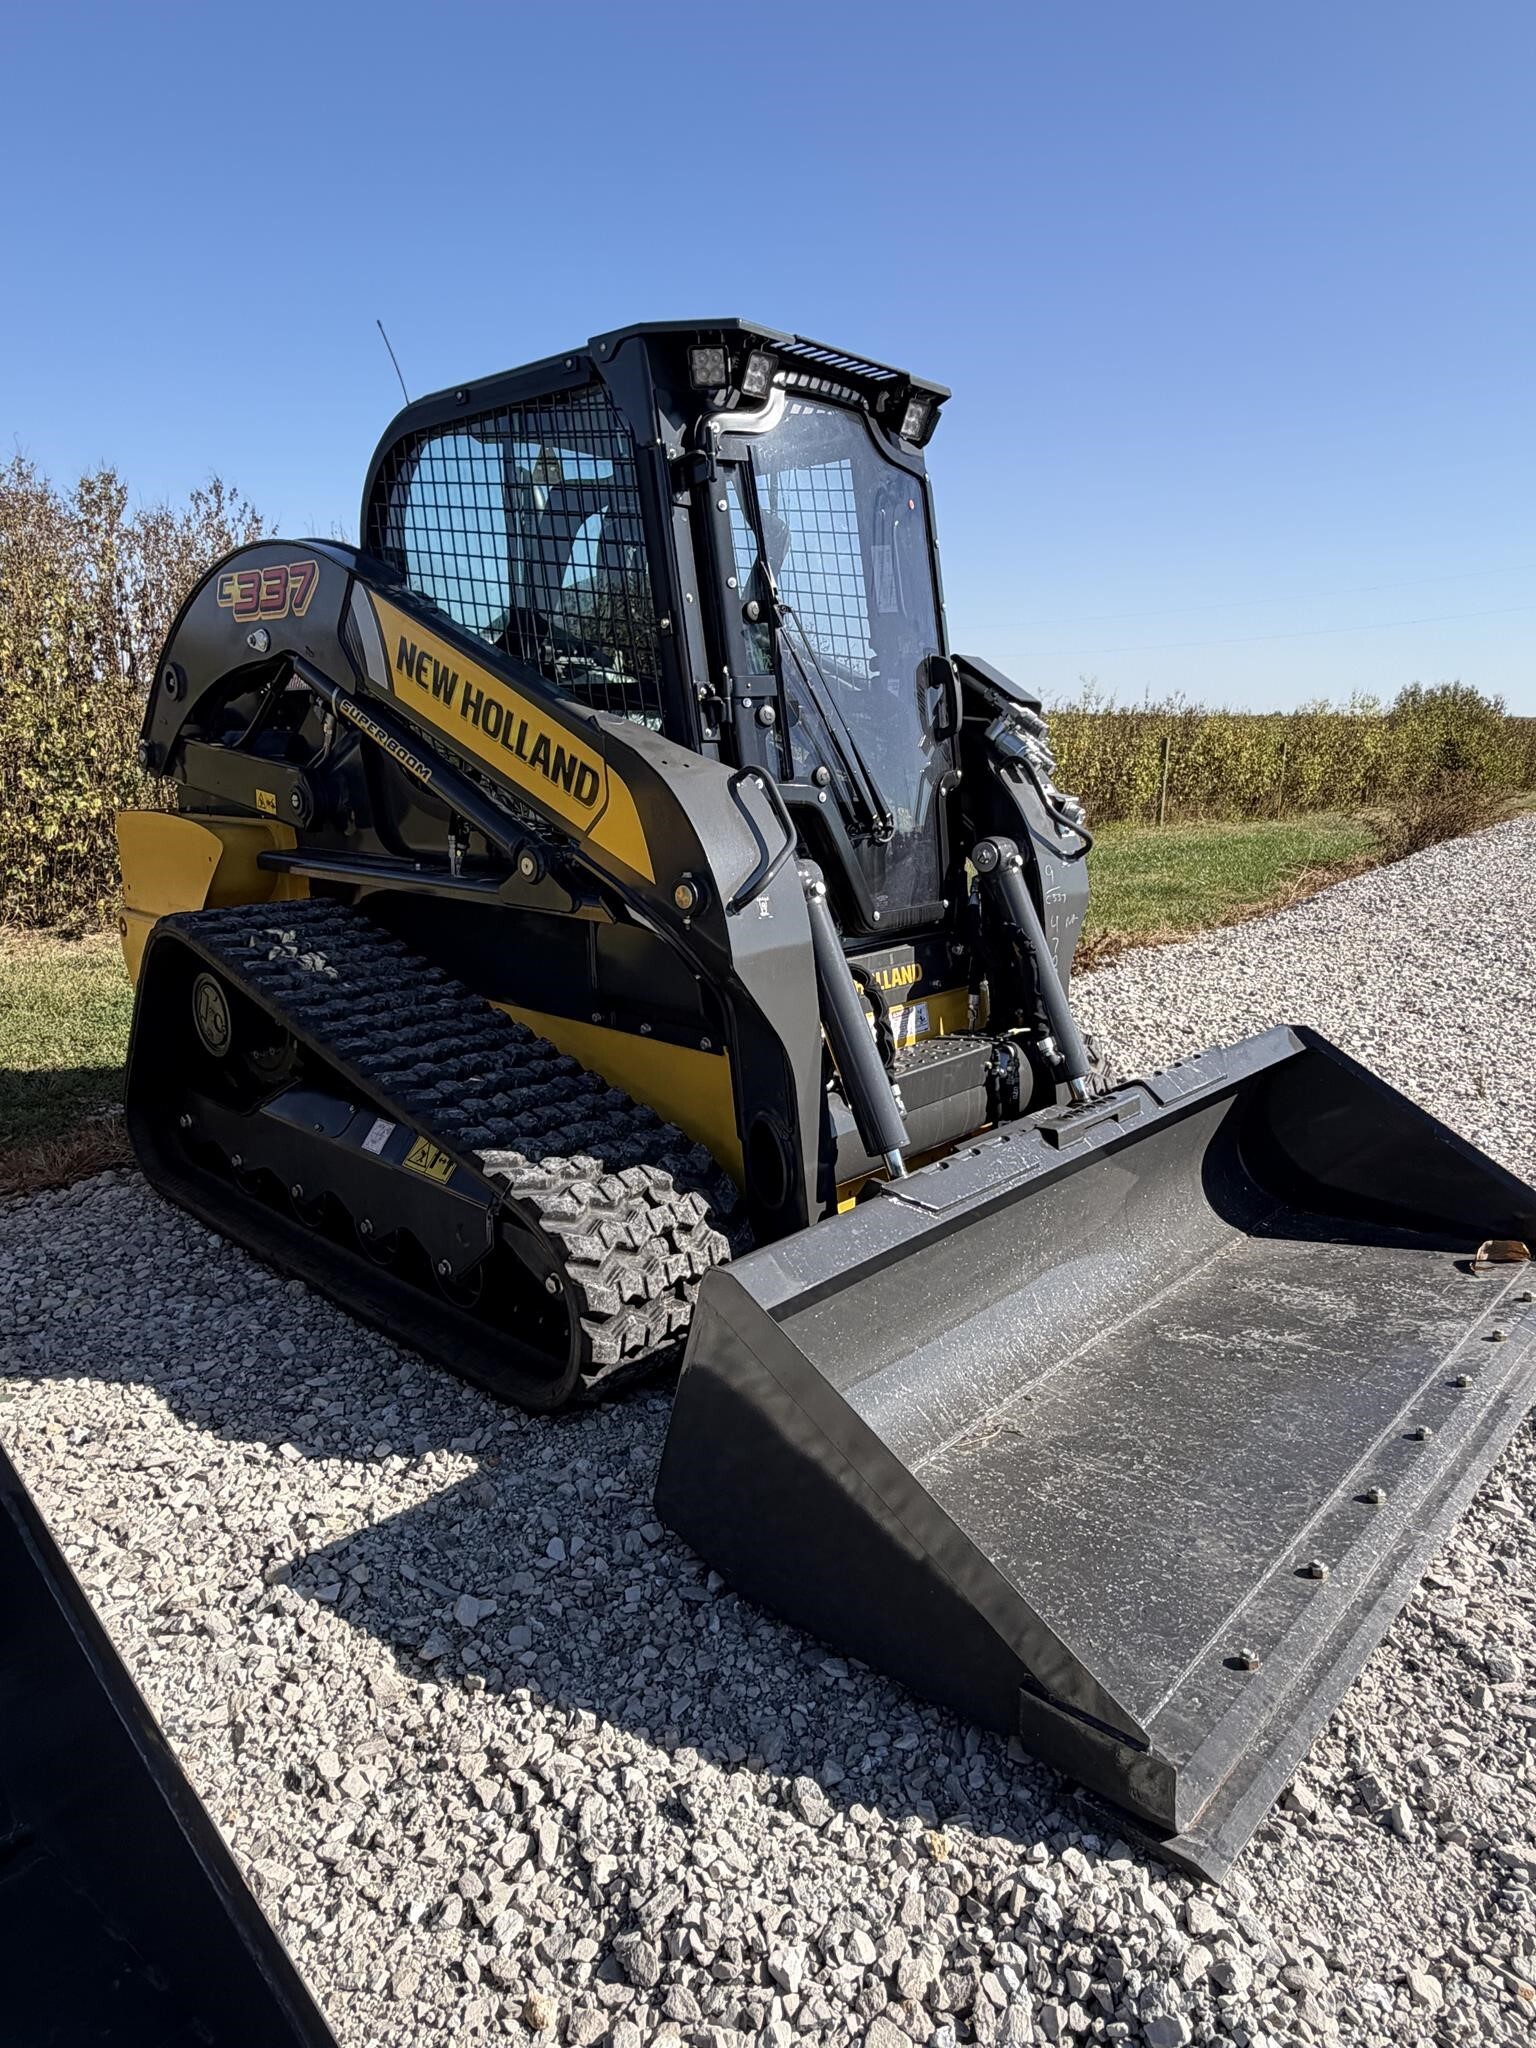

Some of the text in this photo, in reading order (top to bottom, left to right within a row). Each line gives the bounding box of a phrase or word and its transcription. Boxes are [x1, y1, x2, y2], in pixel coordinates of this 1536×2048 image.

[217, 560, 319, 622] C337
[340, 699, 432, 784] SUPER BOOM
[396, 635, 601, 808] NEW HOLLAND
